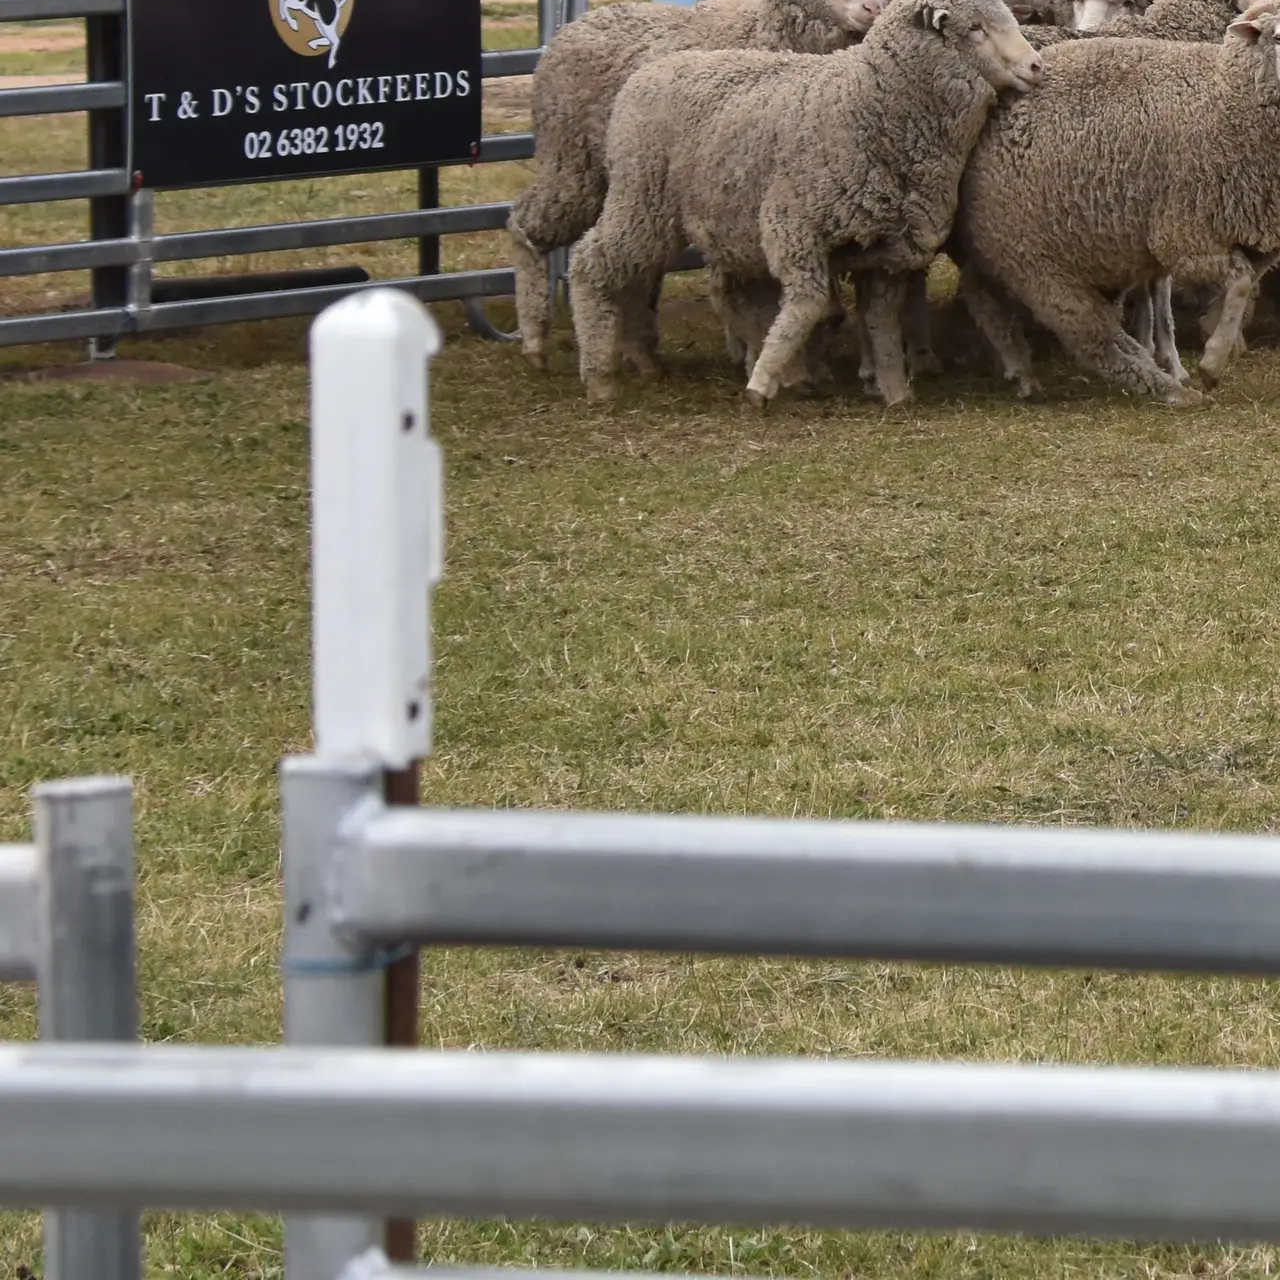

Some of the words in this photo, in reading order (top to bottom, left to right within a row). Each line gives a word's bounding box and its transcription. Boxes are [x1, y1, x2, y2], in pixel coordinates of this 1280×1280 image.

[144, 93, 167, 121] T
[177, 90, 199, 120] &
[211, 85, 261, 117] D'S
[272, 70, 471, 112] STOCKFEEDS
[244, 131, 272, 159] 02
[276, 126, 329, 157] 6382
[334, 121, 385, 152] 1932
